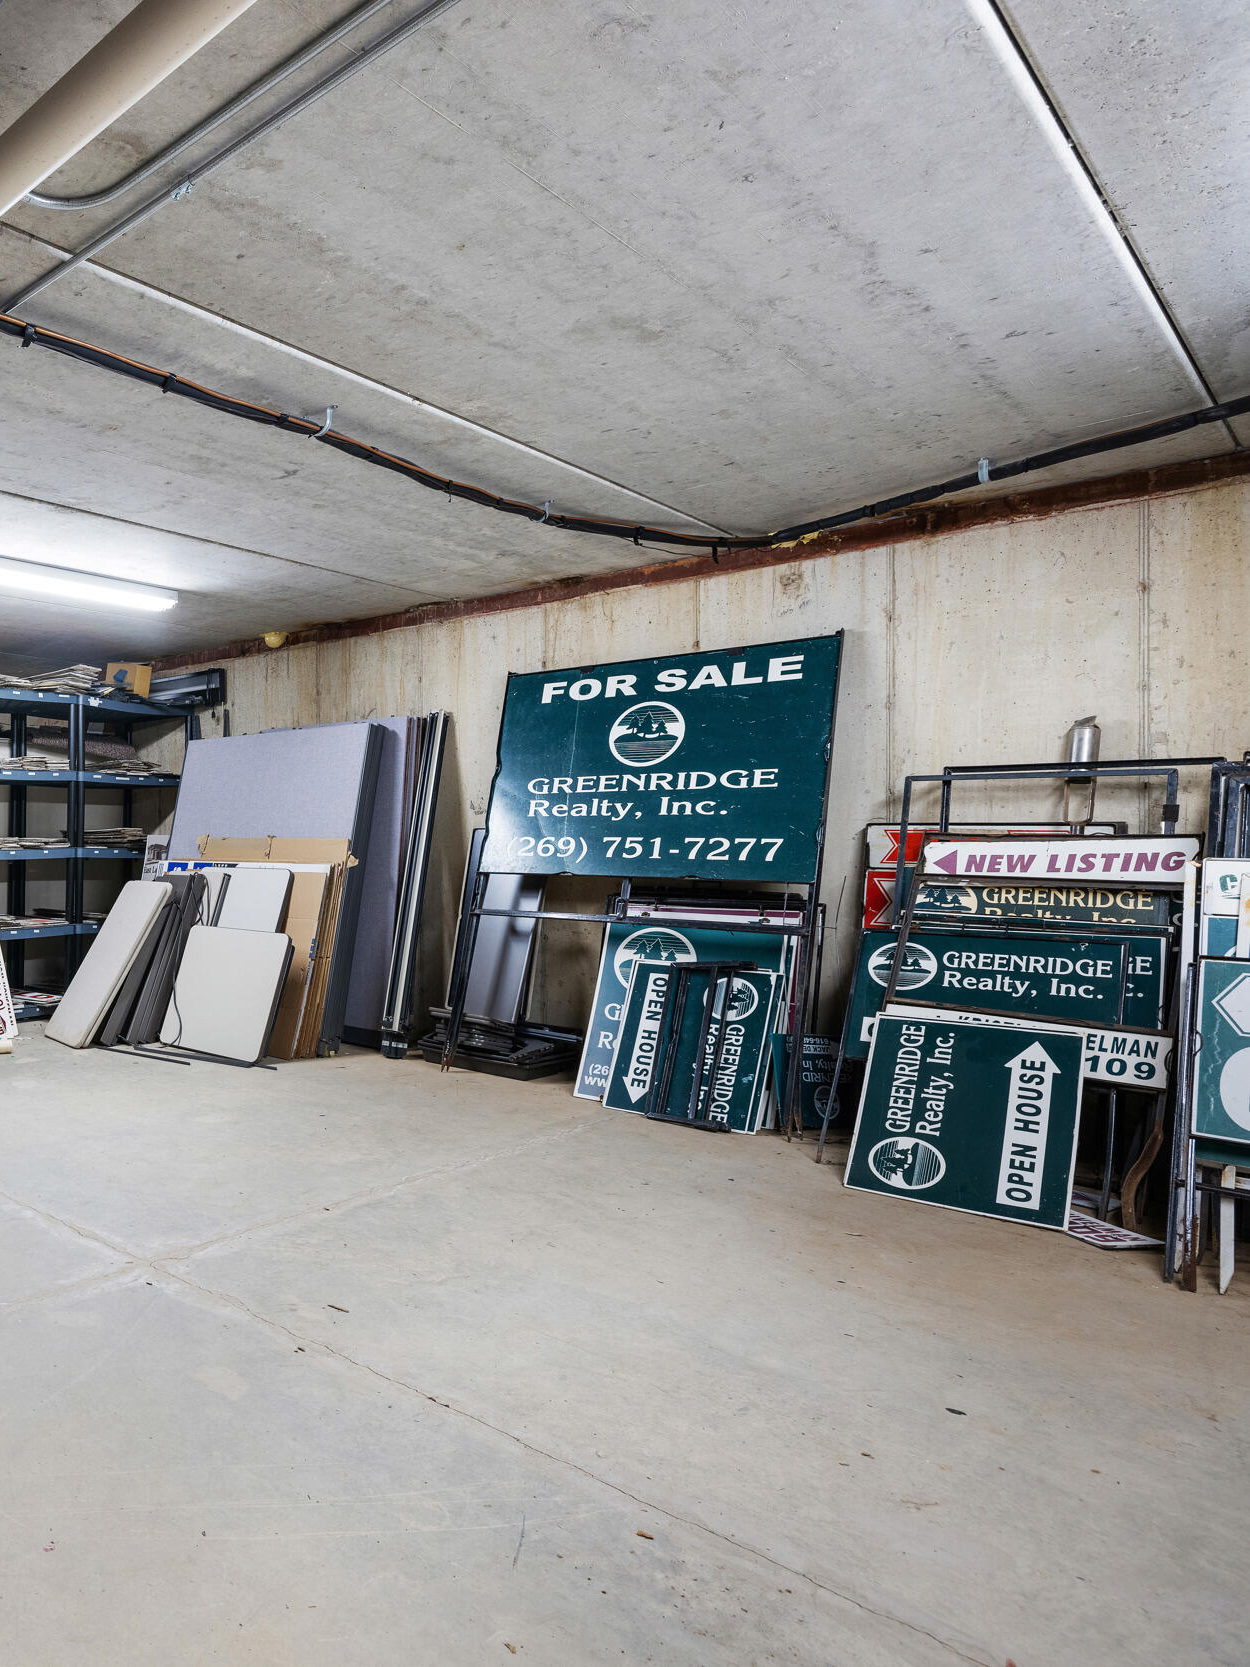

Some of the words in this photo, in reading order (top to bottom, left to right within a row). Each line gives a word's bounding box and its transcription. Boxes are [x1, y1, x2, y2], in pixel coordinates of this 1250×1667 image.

[541, 674, 637, 704] FOR
[655, 654, 805, 693] SALE
[527, 768, 779, 795] GREENRIDGE
[527, 798, 642, 820] Realty,
[658, 796, 728, 816] Inc.
[507, 836, 588, 863] (269)
[602, 836, 784, 861] 751-7277
[964, 853, 1037, 873] NEW
[1045, 851, 1187, 873] LISTING
[982, 887, 1154, 910] GREENRIDGE
[942, 951, 1113, 978] GREENRIDGE
[646, 977, 669, 1022] OPEN
[942, 970, 1037, 998] Realty,
[1049, 978, 1103, 999] Inc.
[630, 1029, 658, 1089] HOUSE
[926, 1032, 956, 1065] Inc.
[1085, 1033, 1159, 1060] ELMAN
[709, 1024, 745, 1126] GREENRIDGE
[885, 1024, 926, 1133] GREENRIDGE
[1085, 1055, 1156, 1080] 109
[915, 1072, 954, 1137] Realty,
[1013, 1059, 1046, 1134] HOUSE
[1005, 1142, 1039, 1203] OPEN
